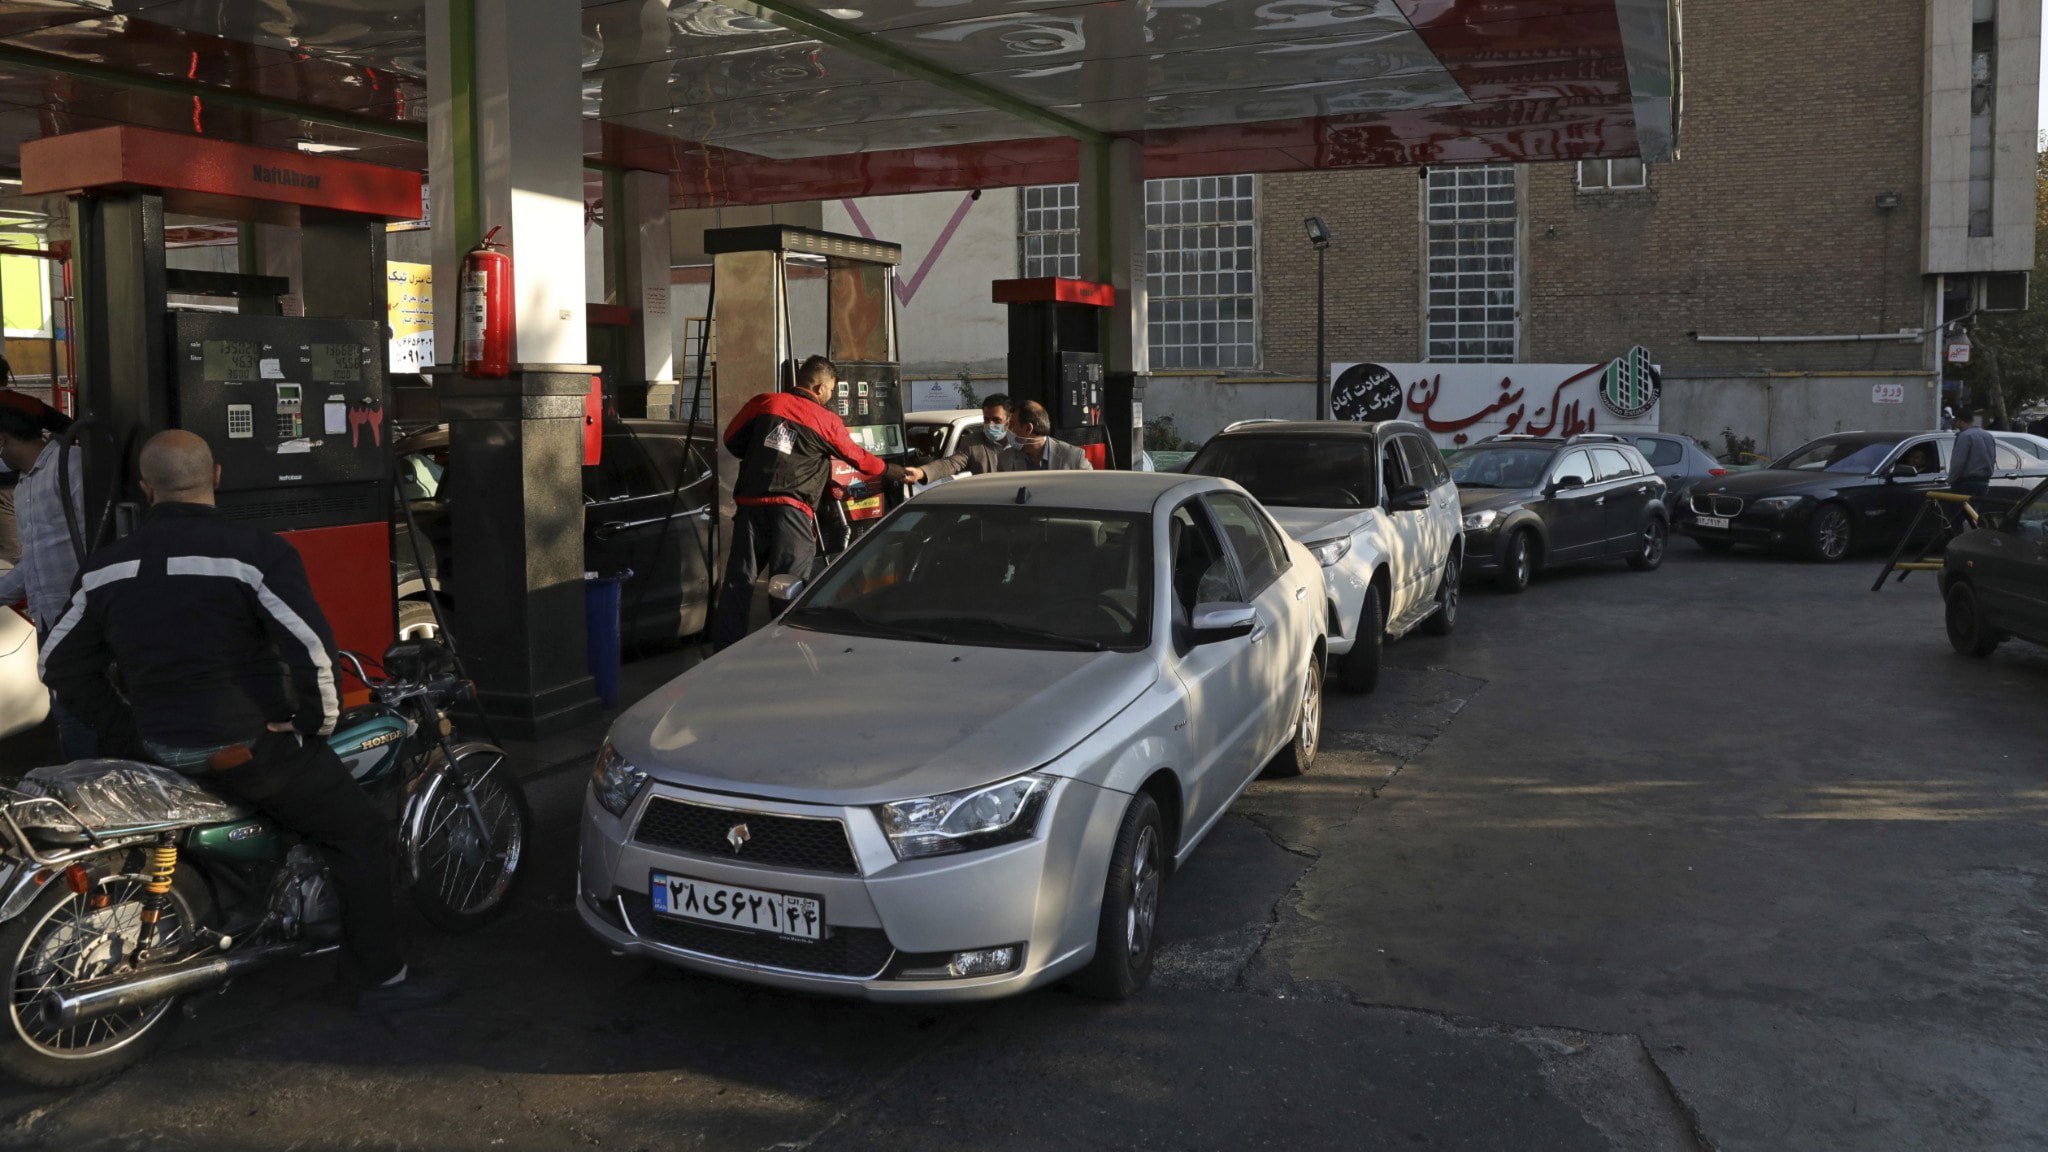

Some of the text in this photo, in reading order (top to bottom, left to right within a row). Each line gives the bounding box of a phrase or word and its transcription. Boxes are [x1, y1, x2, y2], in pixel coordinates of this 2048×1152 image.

[1332, 371, 1391, 411] سعادت آباد
[1369, 385, 1401, 410] شهرک
[1526, 361, 1608, 438] املاک
[1874, 385, 1902, 397] ورود
[786, 906, 817, 936] ۴۴
